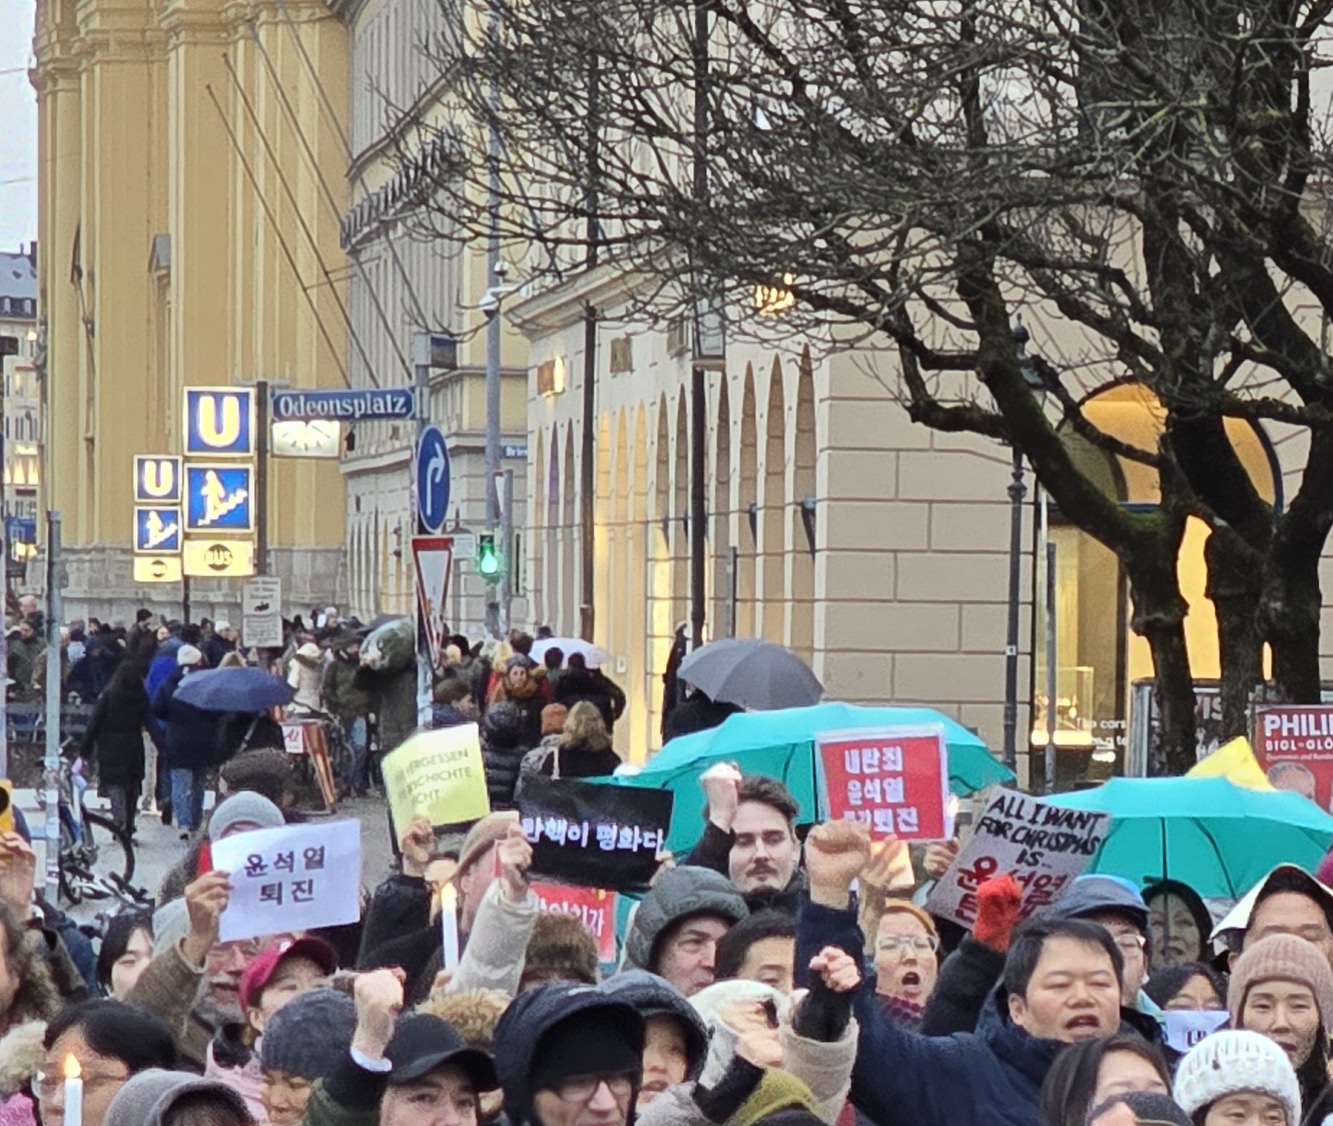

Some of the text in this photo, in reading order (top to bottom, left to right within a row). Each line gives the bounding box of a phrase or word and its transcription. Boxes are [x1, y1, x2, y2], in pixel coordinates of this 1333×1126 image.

[198, 395, 241, 447] U
[279, 394, 408, 419] Odeonsplatz
[143, 460, 174, 497] U
[206, 549, 233, 563] BUS
[987, 794, 1026, 821] ALL
[1041, 806, 1109, 837] WANT
[974, 816, 1101, 856] FOR CHRISTMAS
[244, 845, 326, 878] 윤석열
[259, 878, 315, 906] 퇴진
